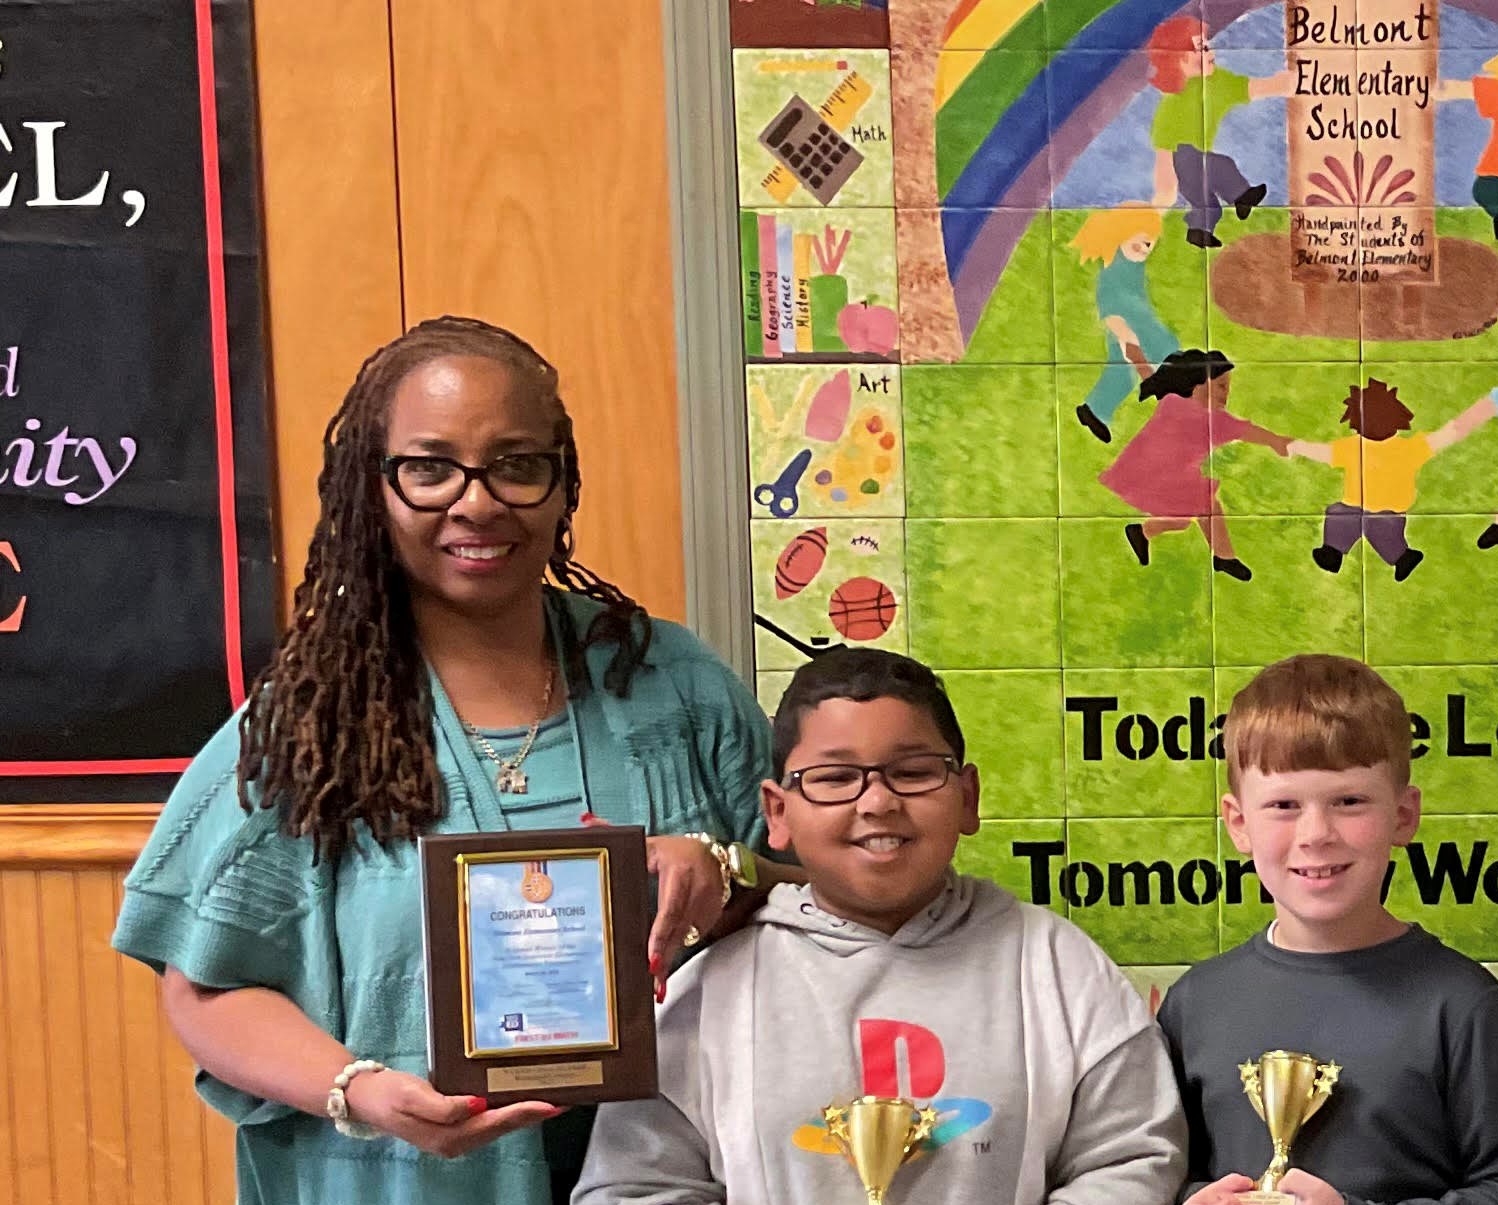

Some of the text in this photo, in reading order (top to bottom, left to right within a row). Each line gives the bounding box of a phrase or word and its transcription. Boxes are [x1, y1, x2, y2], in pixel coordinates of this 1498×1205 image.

[1289, 3, 1431, 46] Belmont
[1296, 60, 1430, 109] Elementary
[851, 124, 887, 143] Math
[1306, 104, 1402, 141] School
[0, 121, 146, 228] L,
[1295, 213, 1407, 236] Handpainted By
[1305, 233, 1330, 247] The
[1341, 231, 1405, 248] Students
[1295, 249, 1432, 272] Belmont Elementary
[1337, 268, 1380, 282] 2000
[765, 271, 780, 340] Geography
[781, 275, 794, 329] Science
[795, 278, 810, 328] History
[857, 372, 891, 394] Art
[0, 418, 137, 505] ity
[1066, 696, 1228, 761] Tod
[490, 906, 586, 921] CONGRATULATIONS
